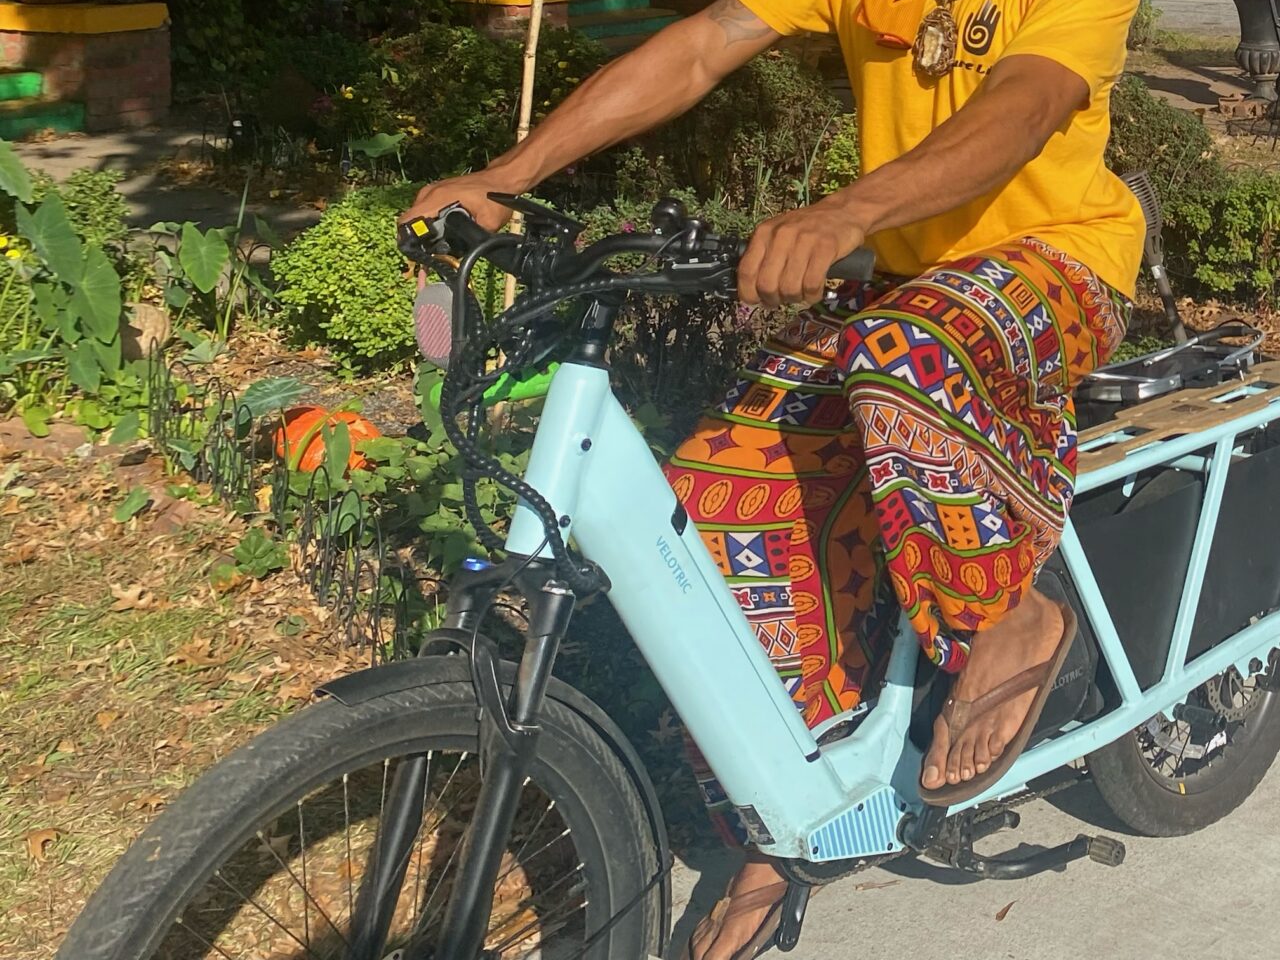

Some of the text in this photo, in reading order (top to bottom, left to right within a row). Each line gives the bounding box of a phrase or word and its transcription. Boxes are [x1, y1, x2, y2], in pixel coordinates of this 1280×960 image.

[976, 64, 992, 75] Li
[656, 535, 693, 595] VELOTRIC
[1051, 666, 1084, 691] LOTRIC
